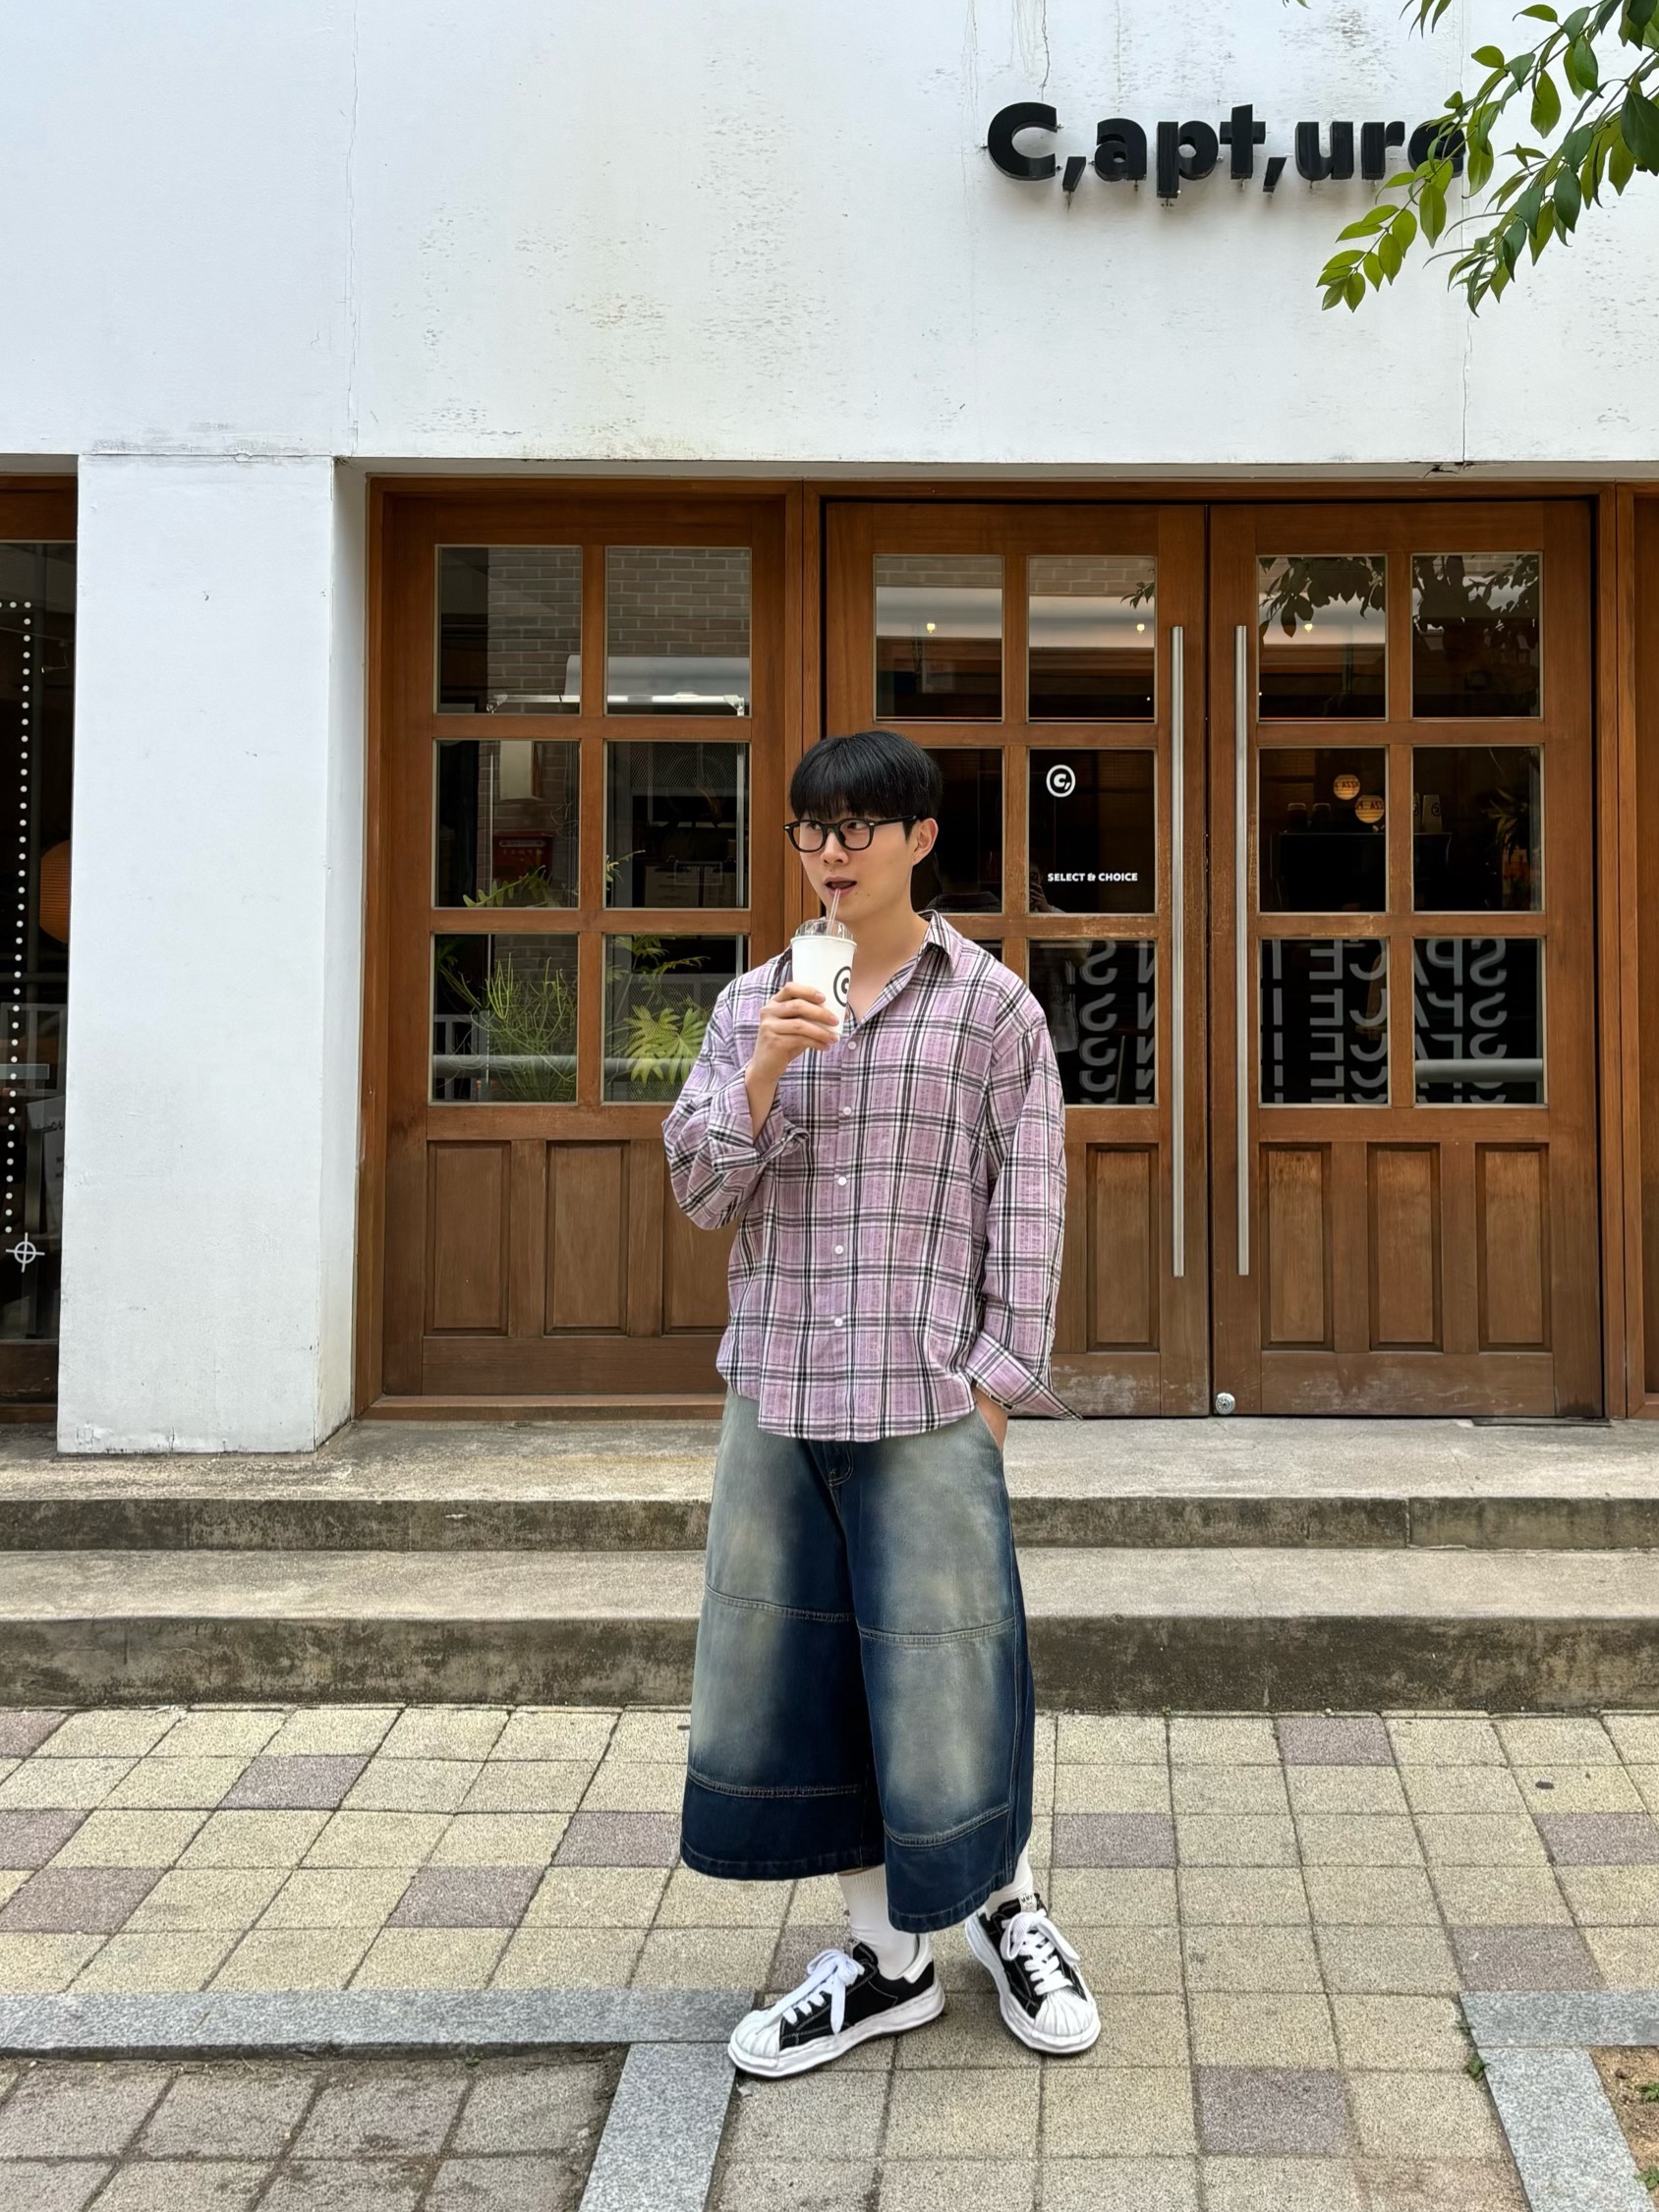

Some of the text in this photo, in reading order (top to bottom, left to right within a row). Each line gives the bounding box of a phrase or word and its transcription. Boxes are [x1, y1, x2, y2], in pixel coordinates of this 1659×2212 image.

[1047, 873, 1138, 881] SELECT & CHOICE
